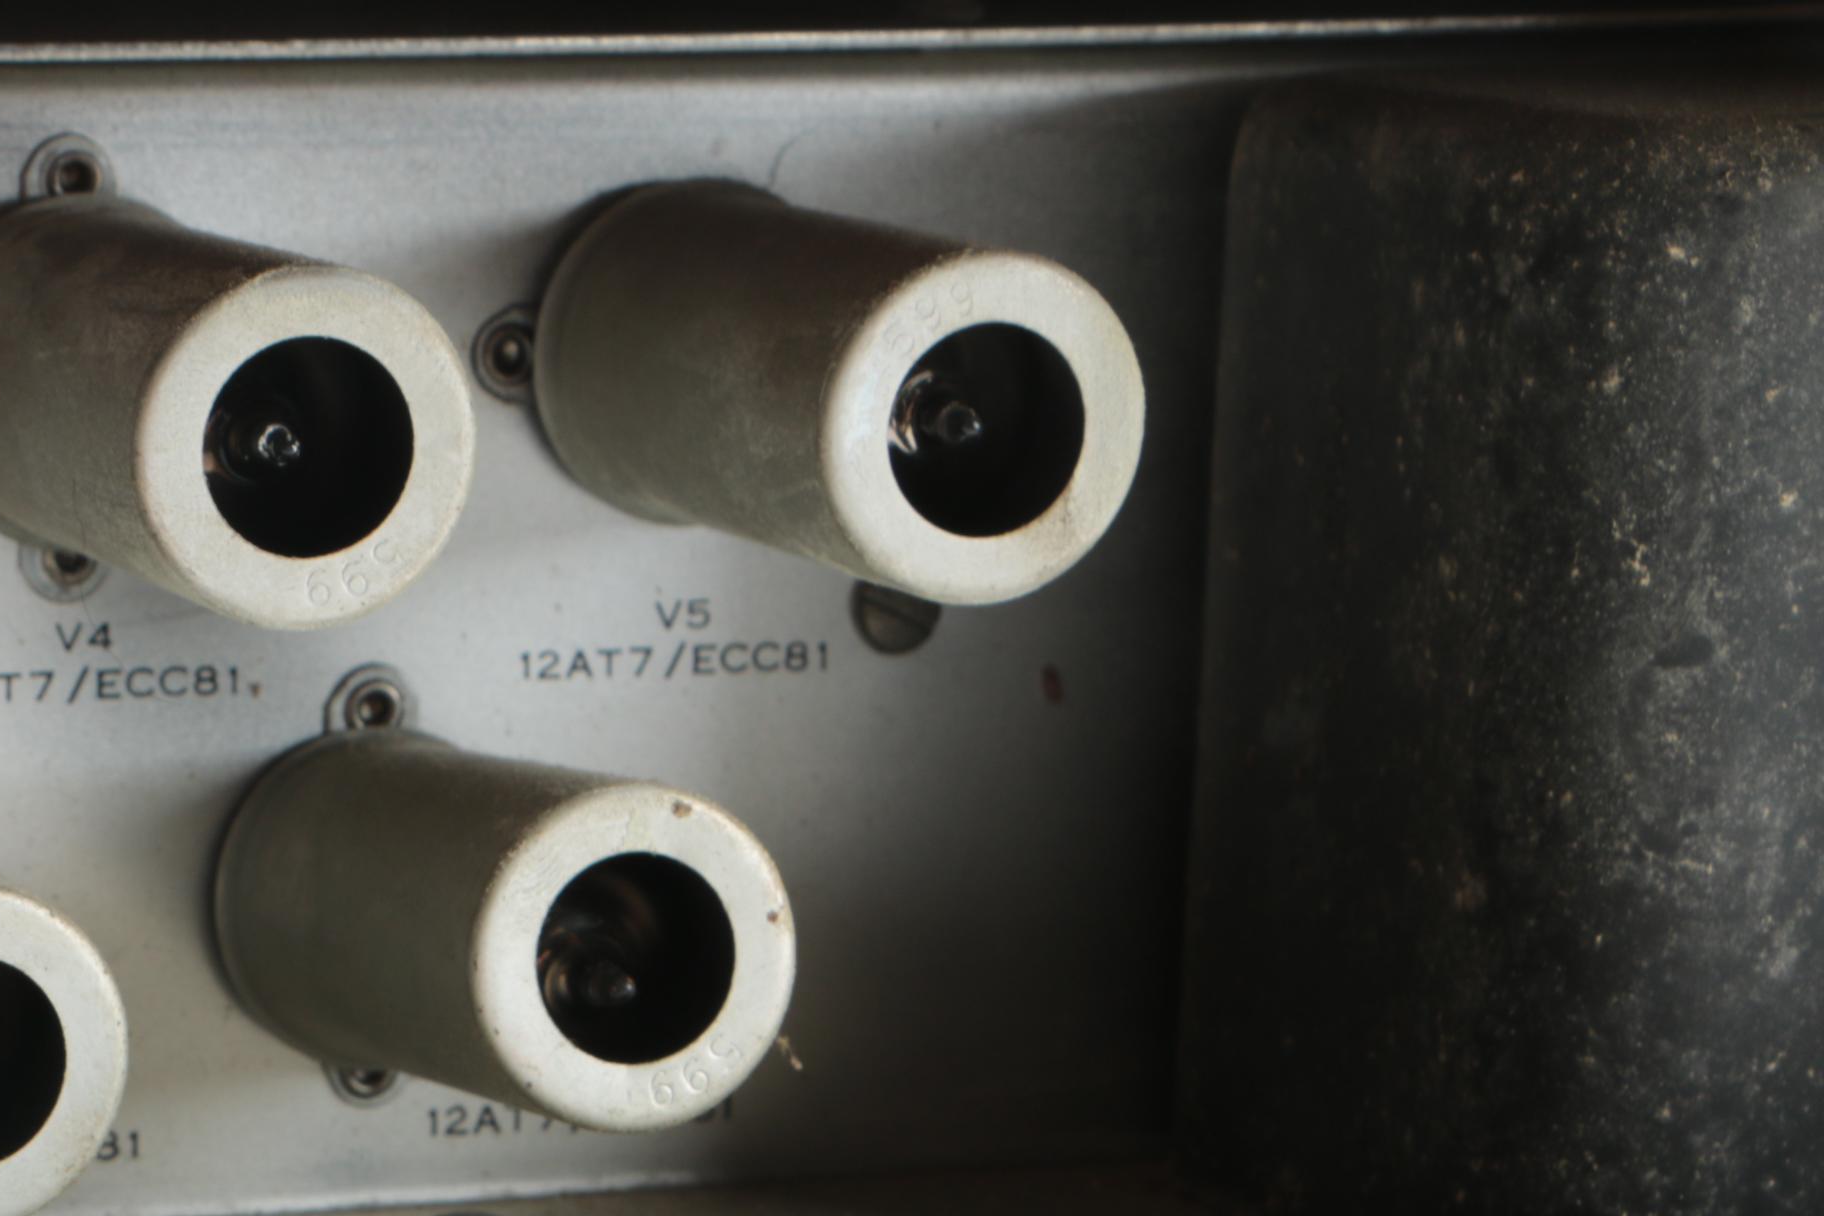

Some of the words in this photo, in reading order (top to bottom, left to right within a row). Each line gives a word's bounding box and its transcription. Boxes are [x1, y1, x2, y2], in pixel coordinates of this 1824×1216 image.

[654, 598, 712, 630] V5
[55, 622, 112, 651] V4
[520, 641, 830, 679] 12AT7/ECC81
